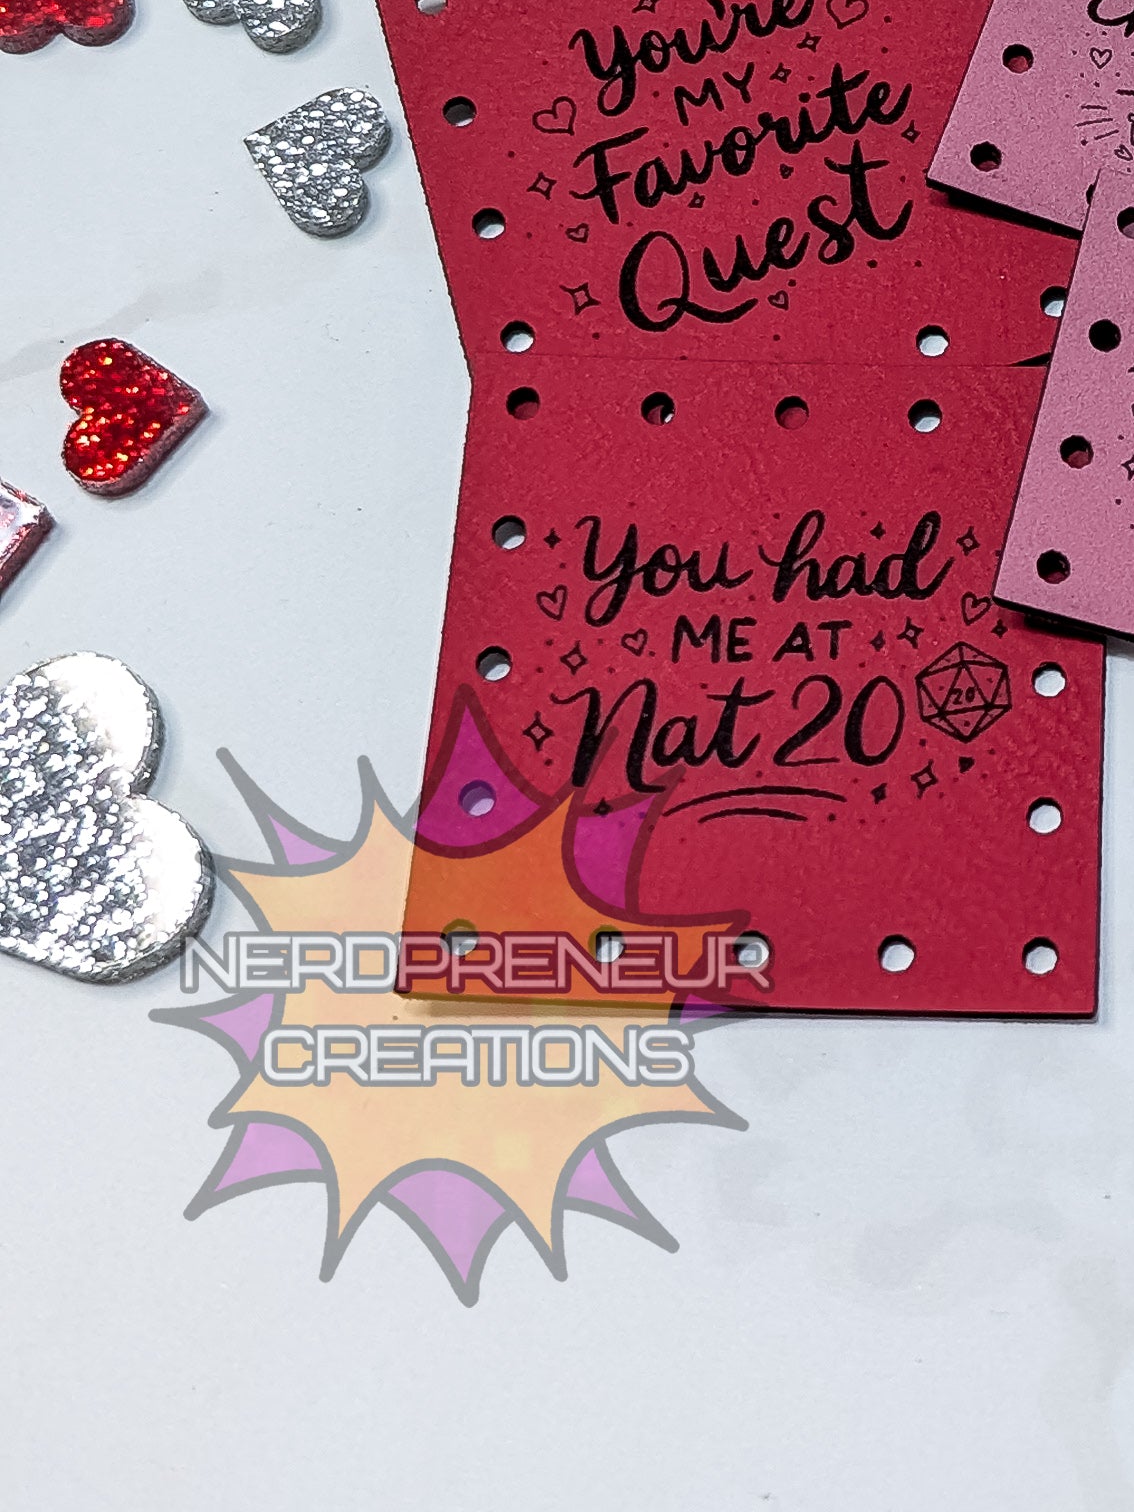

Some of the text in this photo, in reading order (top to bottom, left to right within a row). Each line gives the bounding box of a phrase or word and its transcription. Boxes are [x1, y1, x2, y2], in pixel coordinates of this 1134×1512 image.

[569, 62, 913, 225] Favorite
[674, 62, 754, 126] MY
[618, 139, 914, 333] Quest
[575, 510, 955, 627] You had
[672, 614, 853, 664] ME AT
[950, 687, 976, 705] 20
[550, 675, 905, 794] Nat 20
